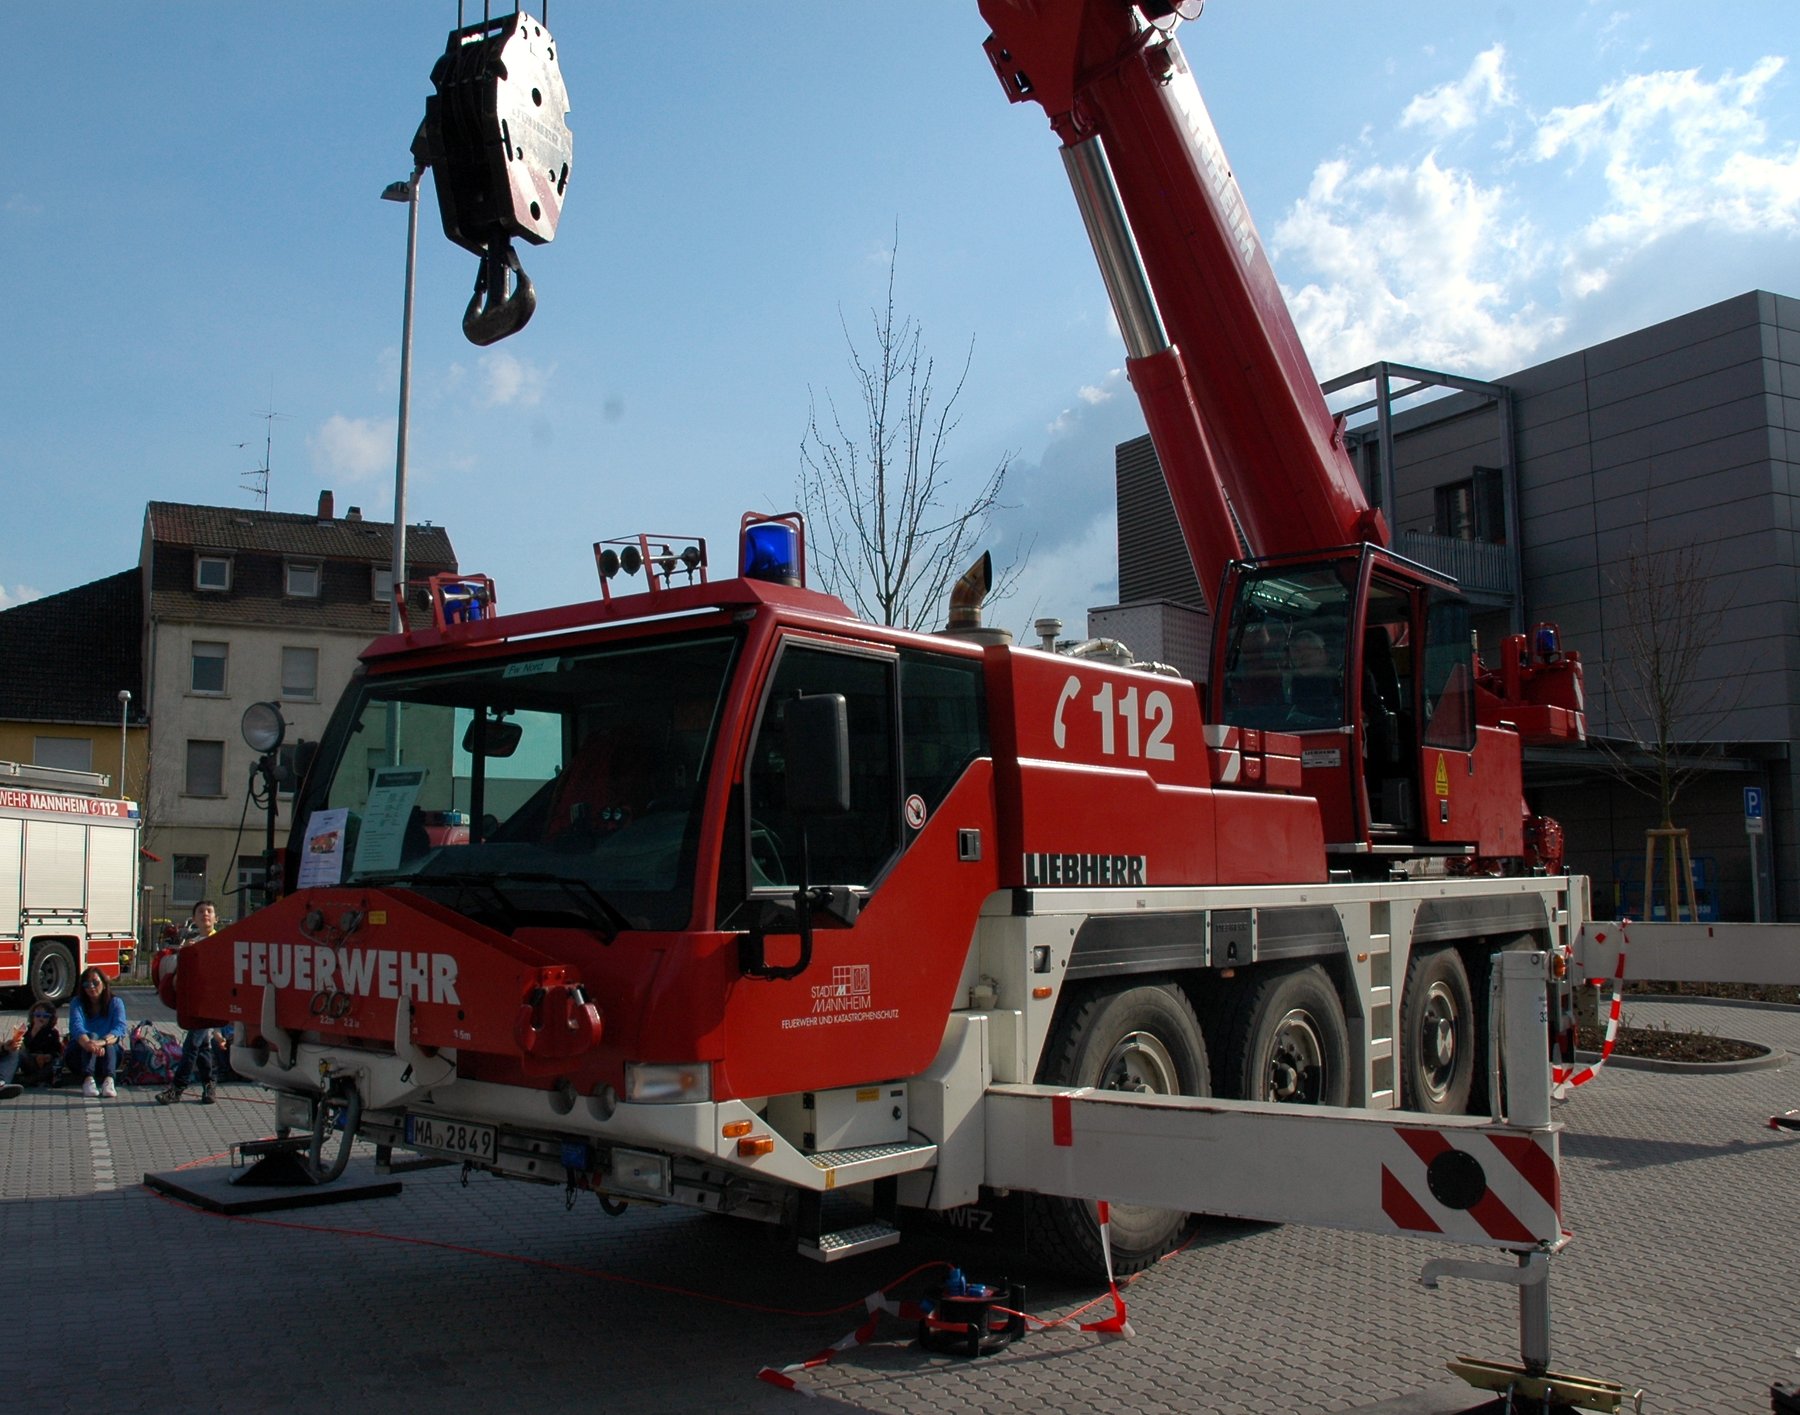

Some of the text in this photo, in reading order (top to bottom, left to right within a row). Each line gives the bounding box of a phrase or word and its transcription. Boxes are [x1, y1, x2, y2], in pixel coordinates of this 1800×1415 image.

[523, 661, 545, 672] Nord
[1092, 682, 1175, 761] 112
[30, 794, 89, 814] MANNHEIM
[100, 801, 119, 816] 112
[1747, 791, 1759, 814] P
[1024, 853, 1146, 885] LIEBHERR
[233, 941, 461, 1006] FEUERWEHR
[811, 985, 835, 998] STADT
[812, 996, 871, 1013] MANNHEIM
[781, 1009, 899, 1029] FEUERWEHR UND KATASTROPHENSCHUTZ
[415, 1119, 491, 1154] MA 2849
[947, 1207, 993, 1233] WFZ
